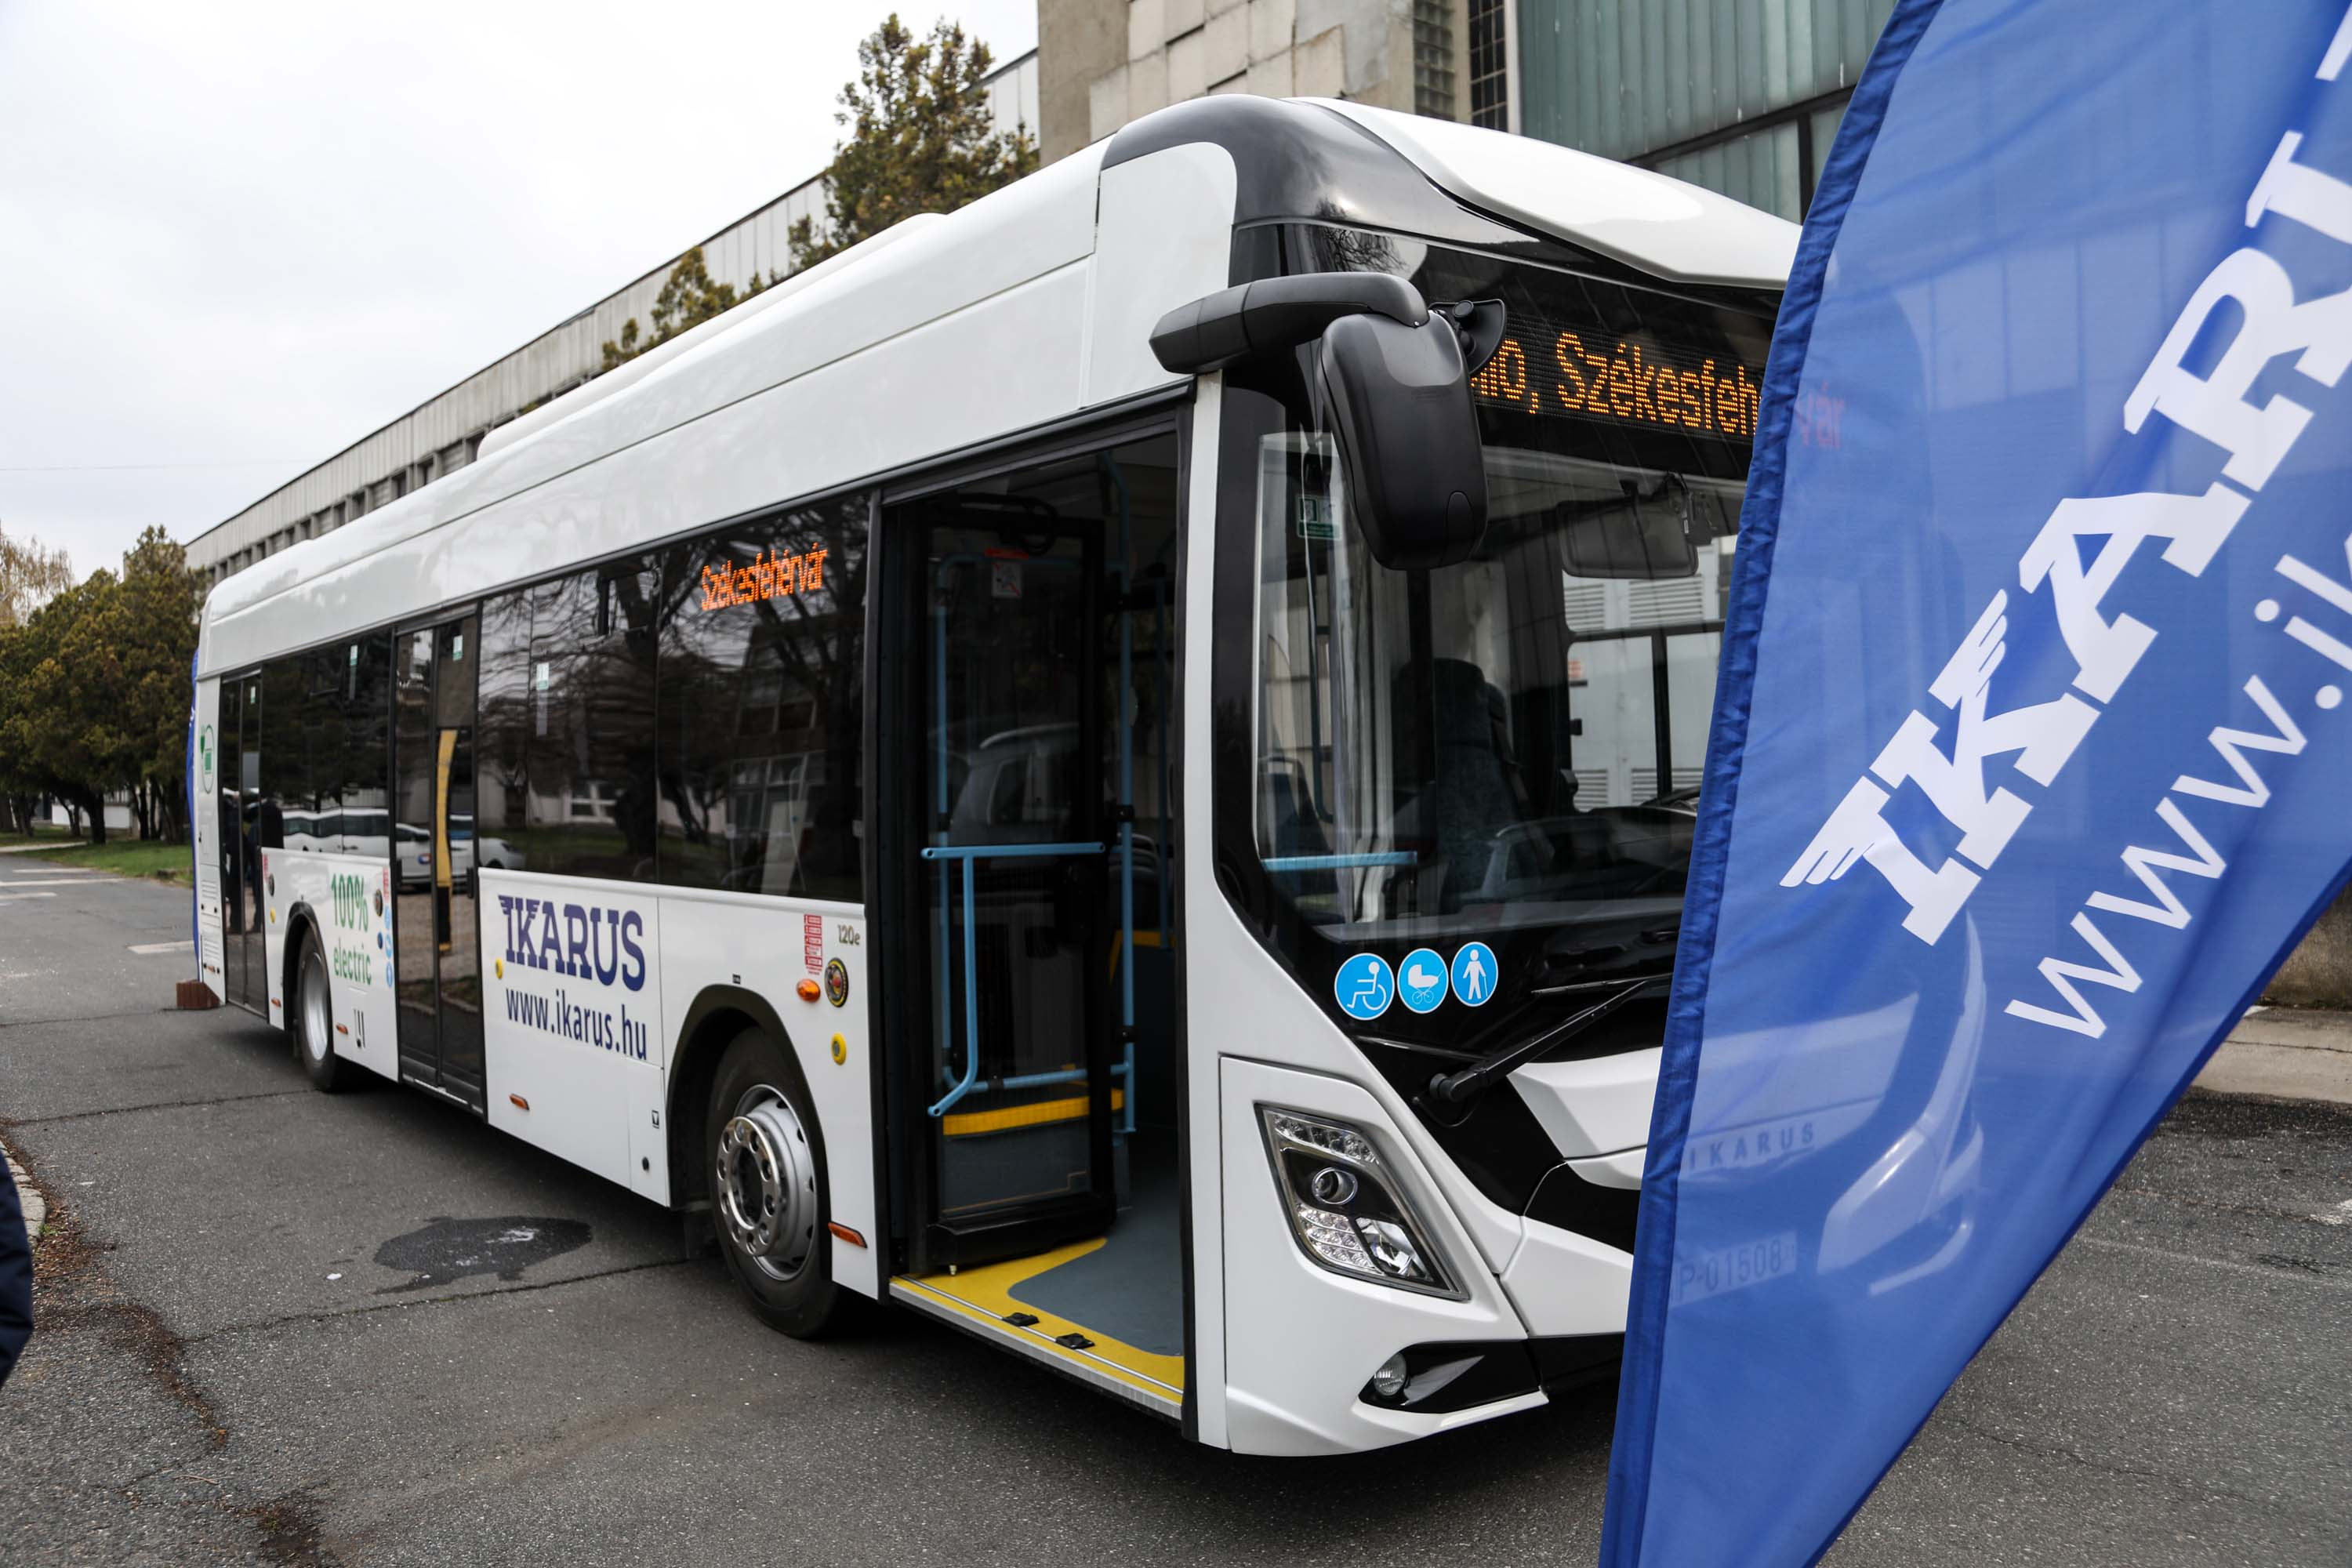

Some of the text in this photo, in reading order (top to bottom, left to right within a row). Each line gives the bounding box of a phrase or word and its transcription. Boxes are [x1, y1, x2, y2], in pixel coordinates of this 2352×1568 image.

[702, 542, 829, 612] Székesfehérvár
[331, 873, 368, 932] 100%
[333, 936, 372, 985] electric
[498, 895, 645, 992] IKARUS
[837, 924, 861, 946] 120e
[506, 988, 647, 1060] www.ikarus.hu
[1690, 1123, 1813, 1170] IKARUS
